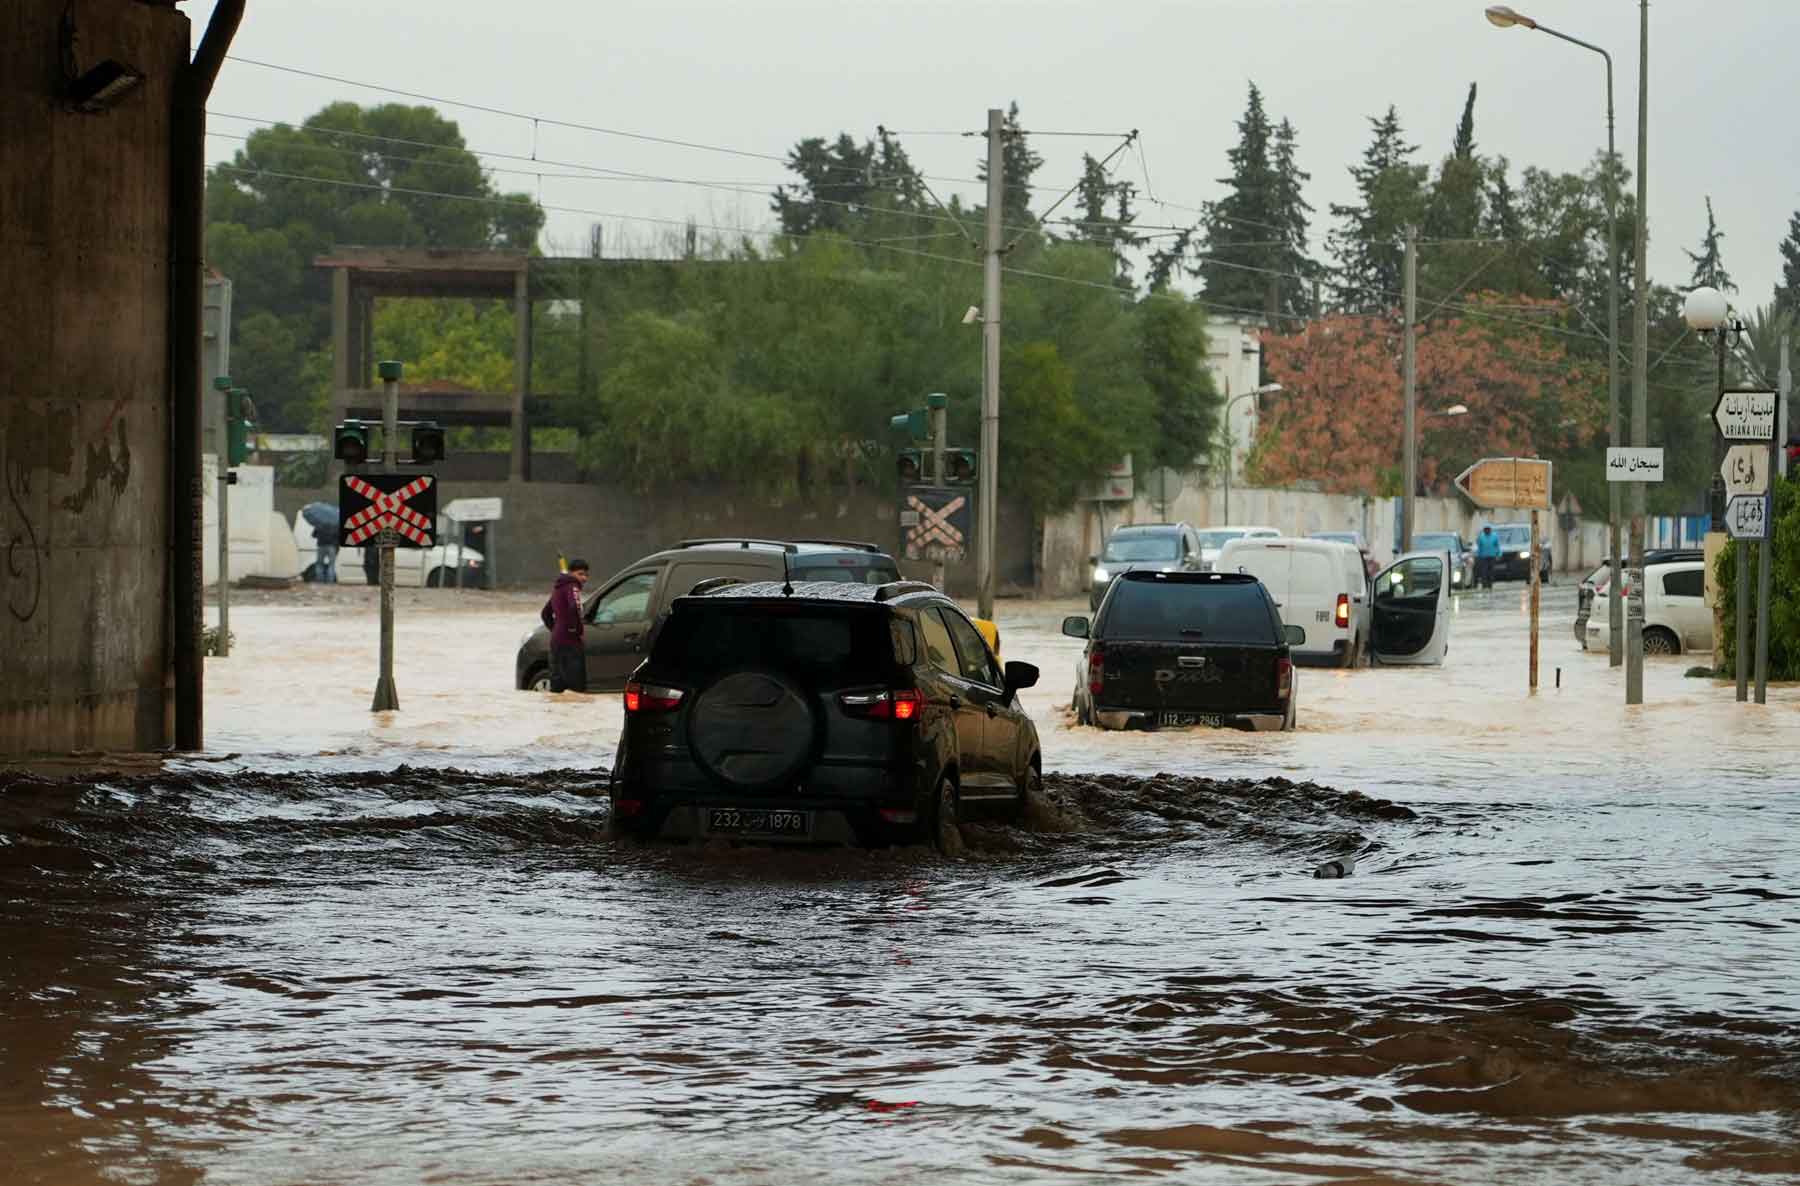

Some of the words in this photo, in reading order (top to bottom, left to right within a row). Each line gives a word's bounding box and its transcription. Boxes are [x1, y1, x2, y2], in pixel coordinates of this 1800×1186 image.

[1726, 424, 1750, 437] ARIANA
[1752, 424, 1772, 437] VILLE
[1610, 456, 1627, 468] الله
[1629, 456, 1660, 472] سبحان
[713, 812, 740, 827] 232
[768, 814, 801, 829] 1878
